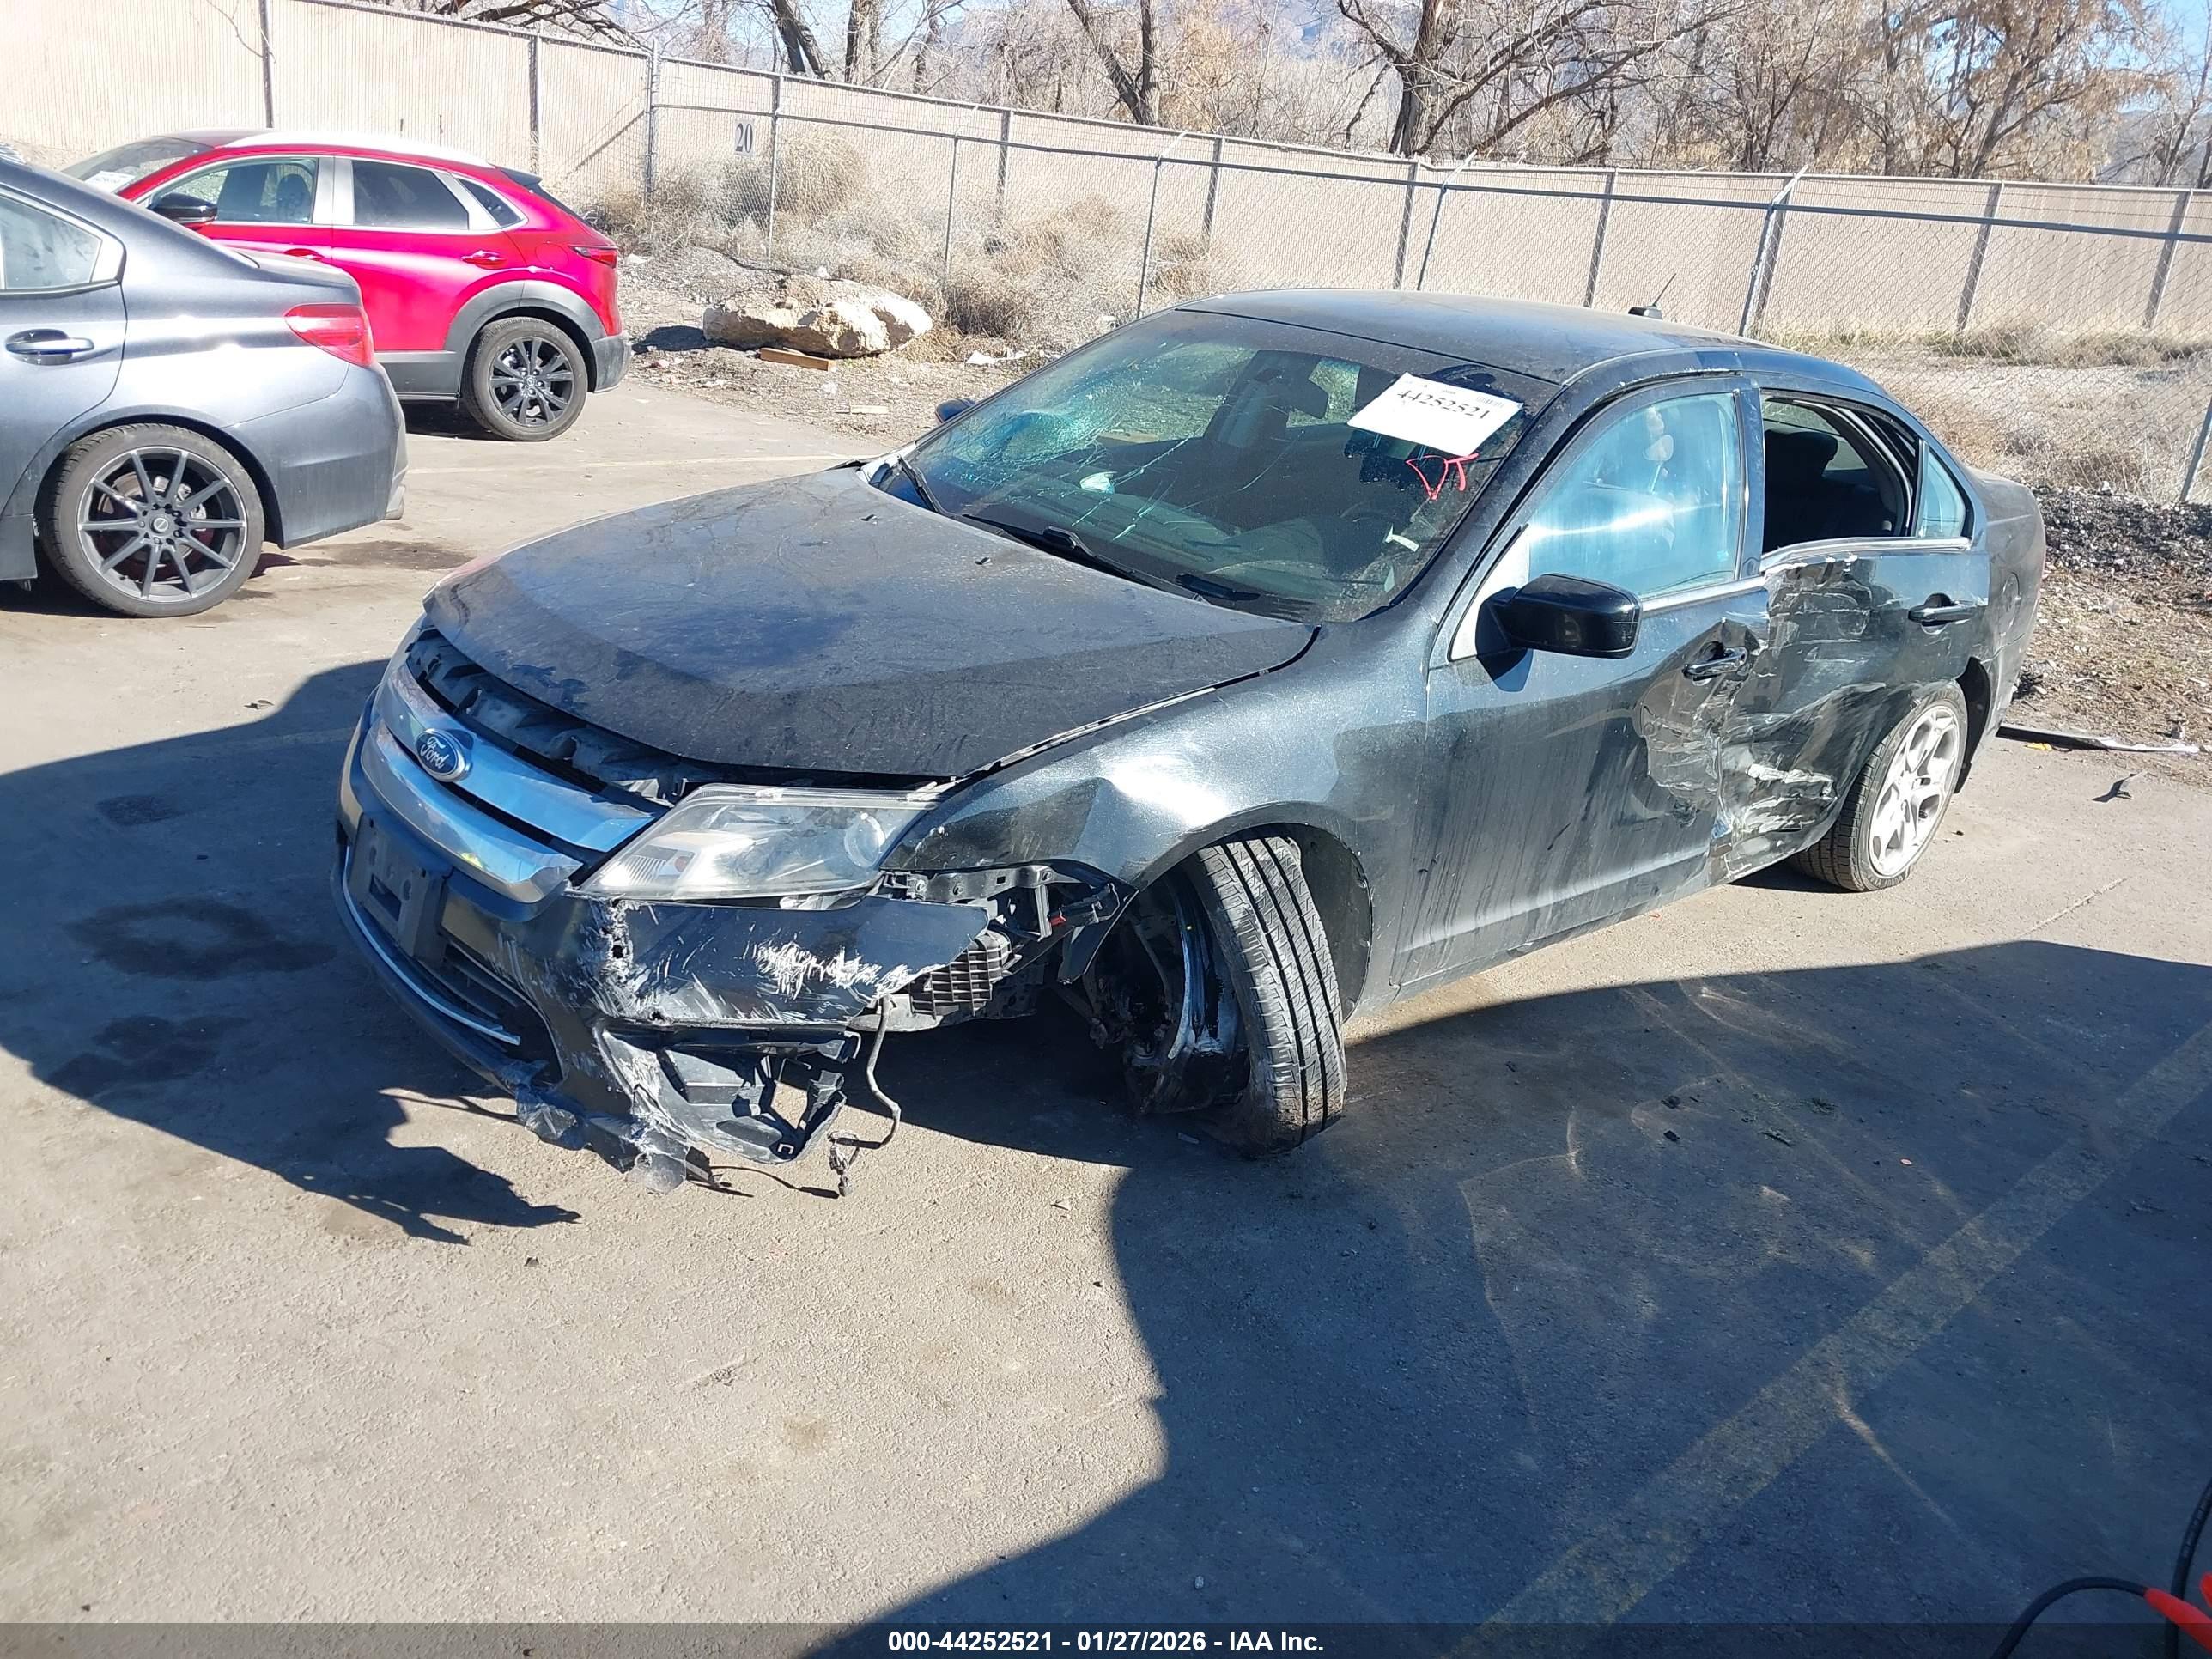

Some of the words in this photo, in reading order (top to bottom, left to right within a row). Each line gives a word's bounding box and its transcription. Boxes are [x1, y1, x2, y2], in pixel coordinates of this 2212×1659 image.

[735, 122, 754, 154] 20
[1396, 390, 1491, 419] 44252521
[420, 736, 450, 769] Ford
